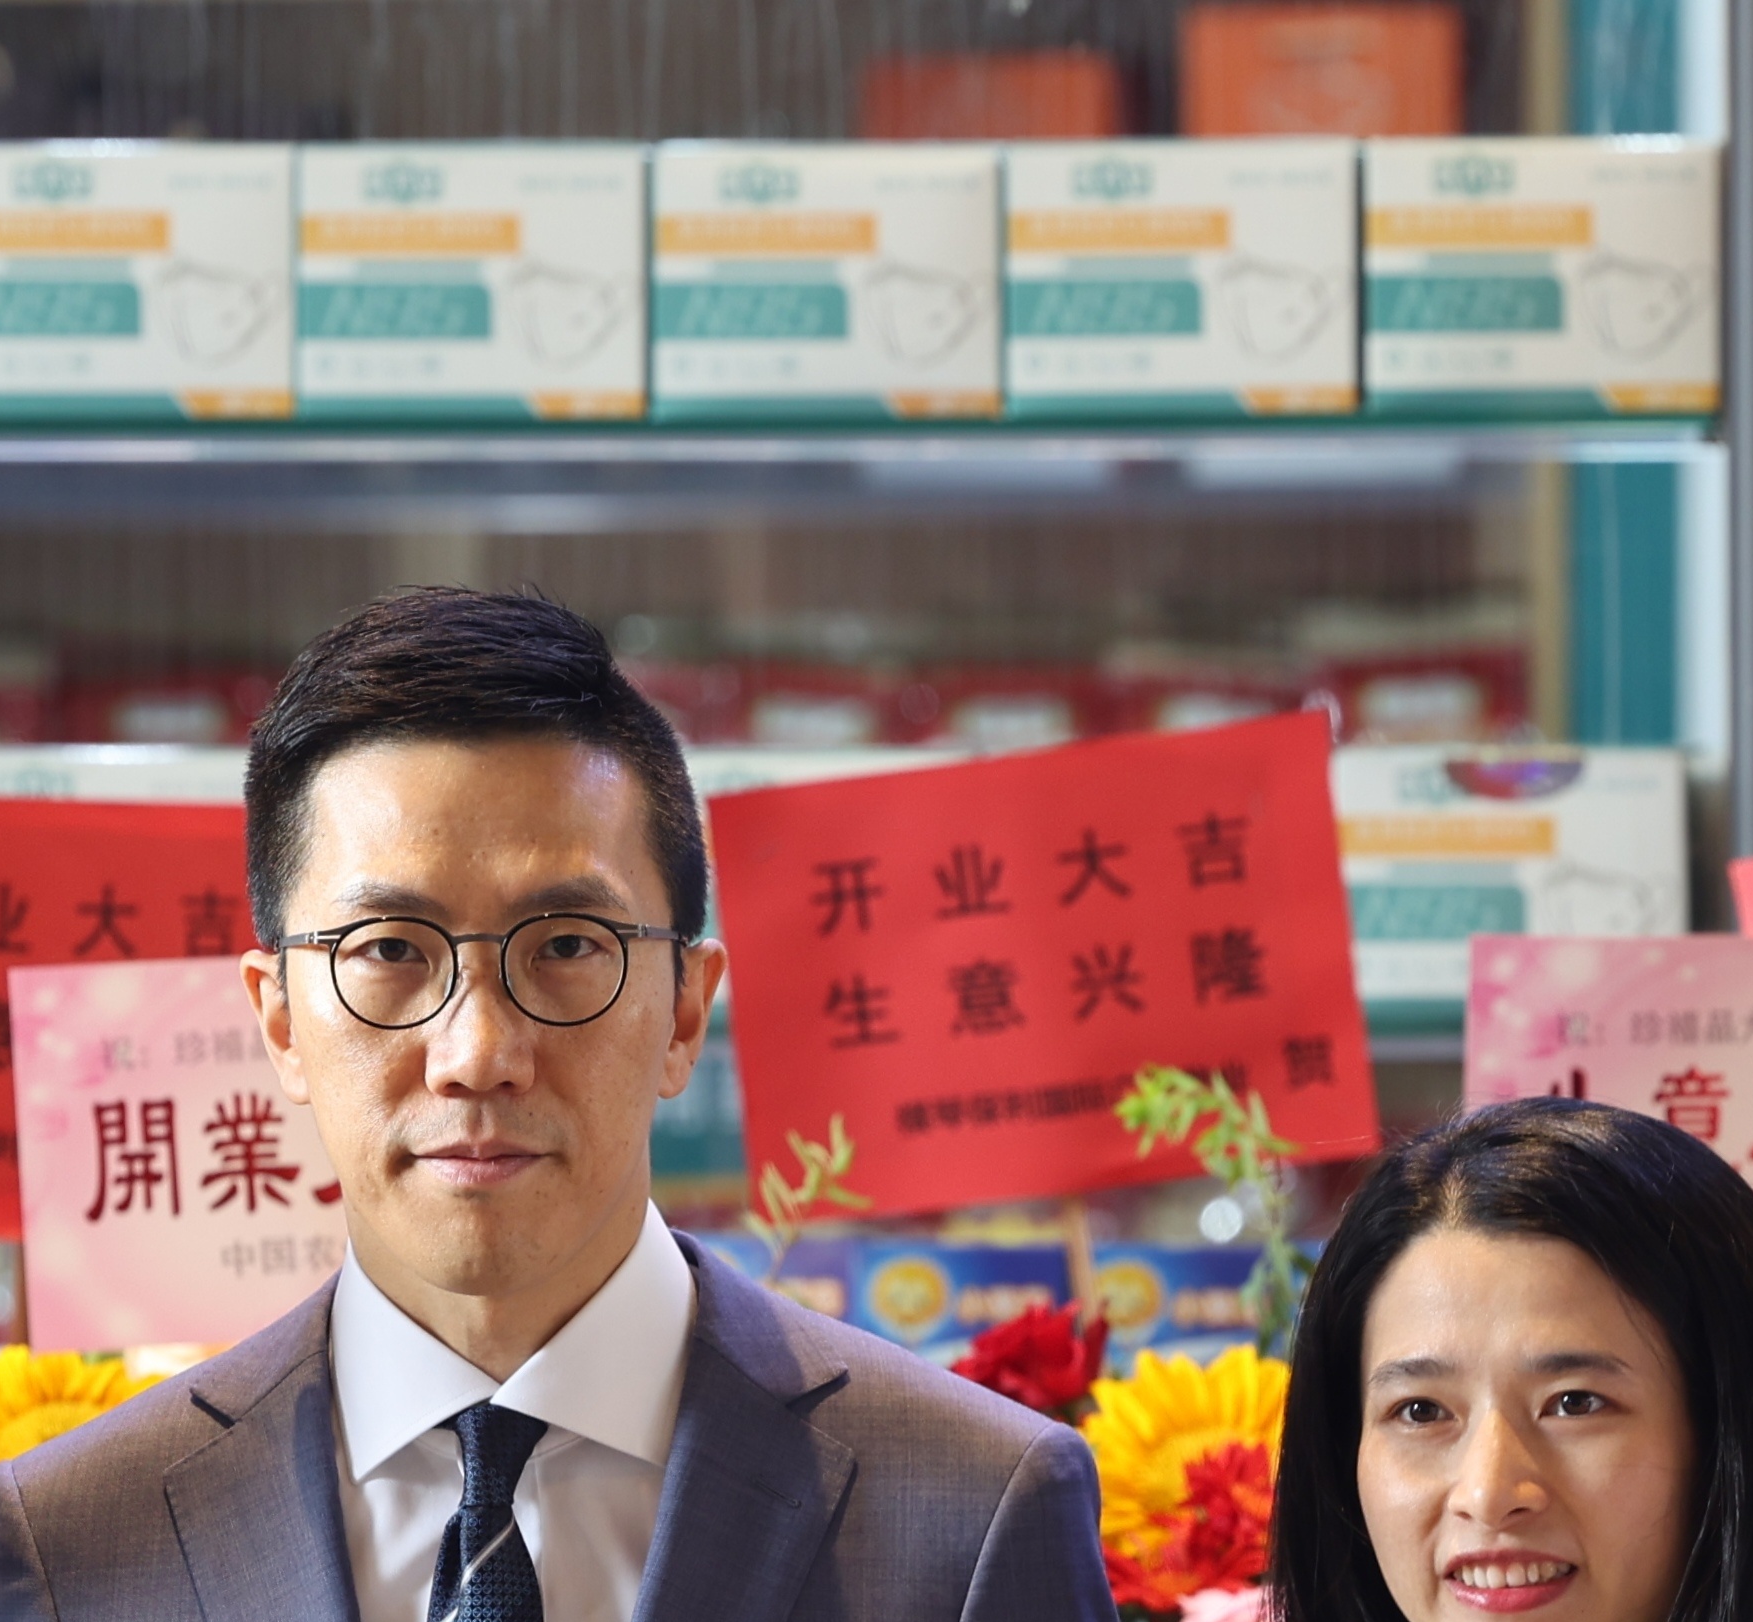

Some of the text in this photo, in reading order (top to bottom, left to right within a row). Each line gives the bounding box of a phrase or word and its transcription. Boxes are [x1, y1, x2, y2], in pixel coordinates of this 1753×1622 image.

[809, 812, 1250, 936] 开业大吉
[824, 927, 1266, 1048] 生意兴隆
[1283, 1035, 1334, 1091] 贺
[85, 1093, 344, 1221] 開業
